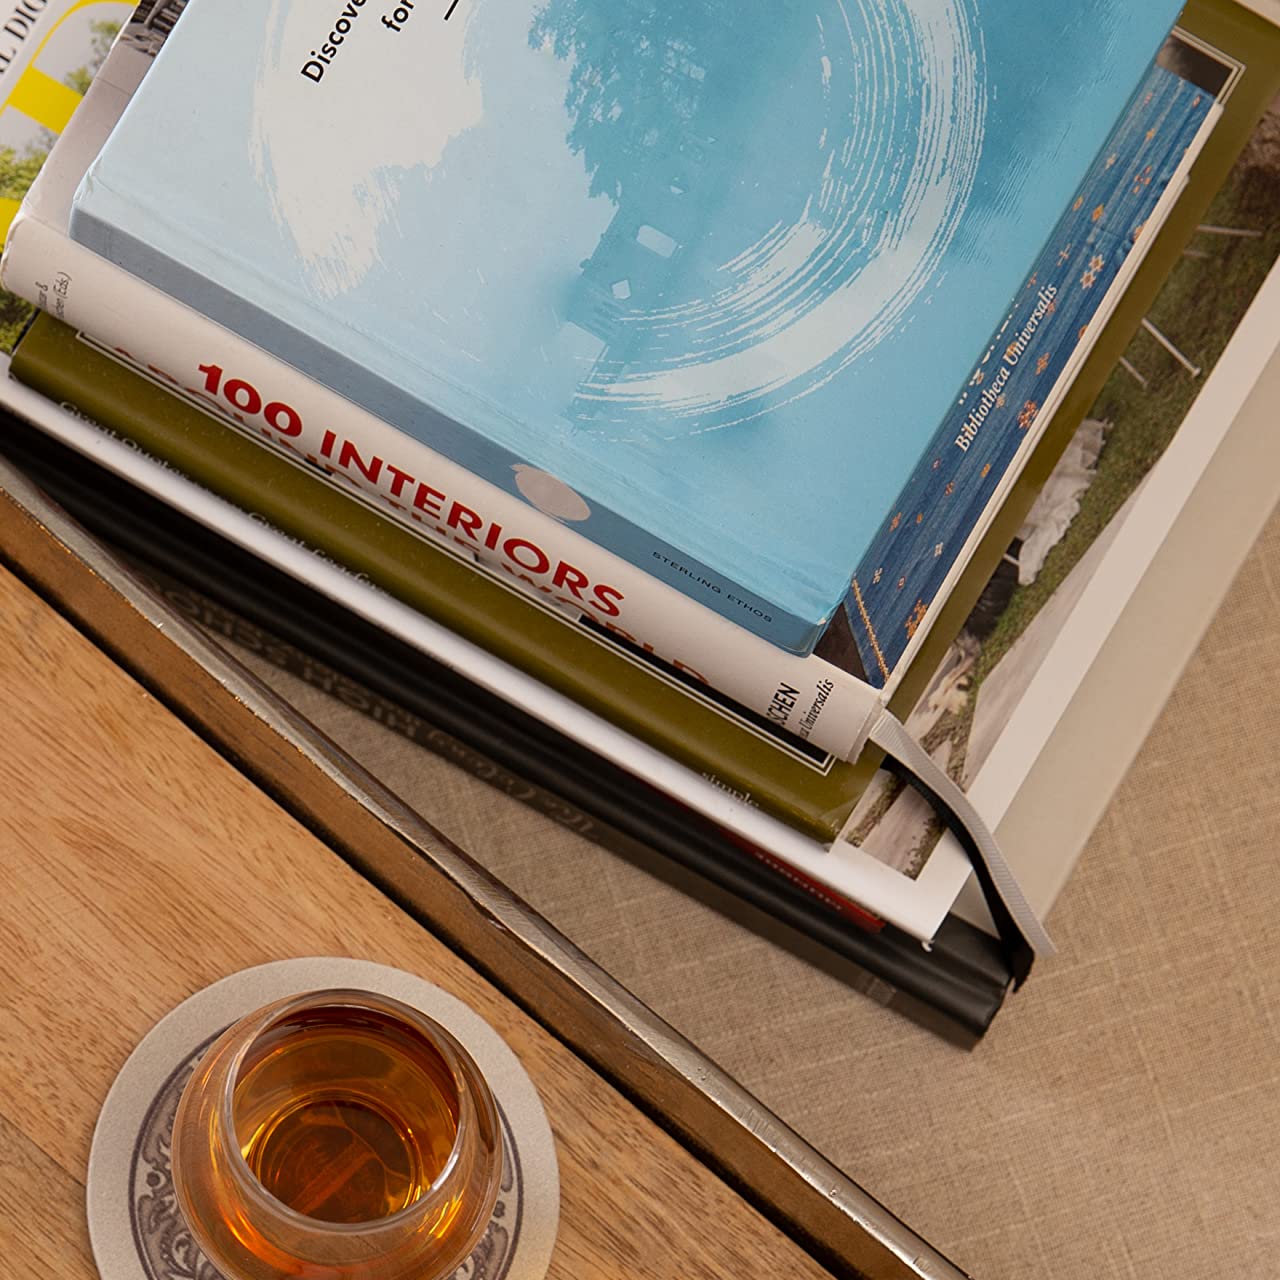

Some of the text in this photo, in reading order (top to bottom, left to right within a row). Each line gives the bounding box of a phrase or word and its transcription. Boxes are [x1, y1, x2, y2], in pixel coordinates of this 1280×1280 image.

[954, 366, 1011, 453] Bibliotheca
[1002, 283, 1058, 366] Universalis
[197, 363, 303, 438] 100
[319, 429, 625, 618] INTERIORS
[652, 551, 773, 623] STERLING ETHOS
[799, 678, 834, 730] Universalis
